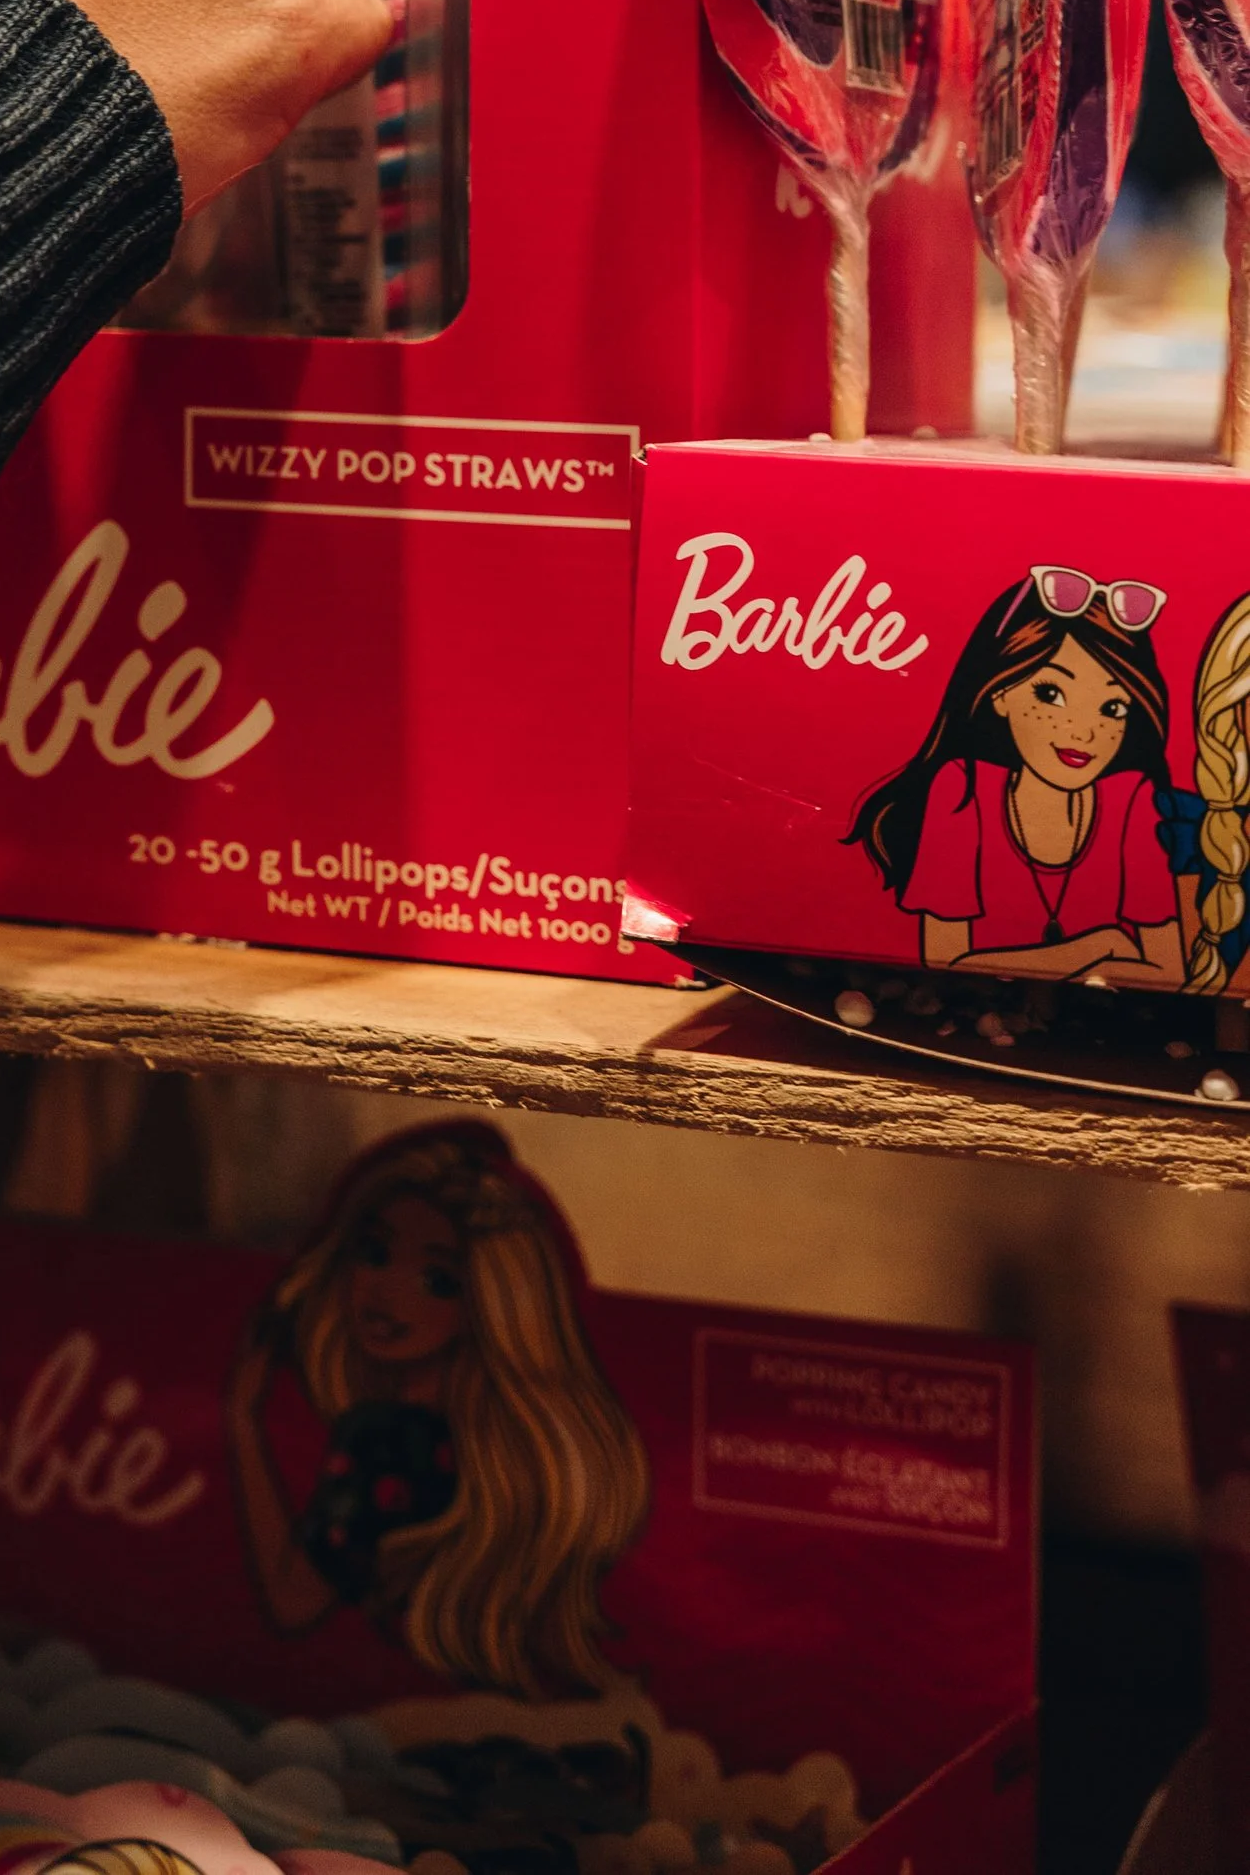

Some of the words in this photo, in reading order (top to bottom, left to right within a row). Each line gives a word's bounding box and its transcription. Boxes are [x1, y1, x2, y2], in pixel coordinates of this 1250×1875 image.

[207, 443, 327, 480] WIZZY
[337, 449, 416, 484] POP
[661, 532, 929, 671] Barbie
[259, 849, 282, 885] g
[267, 889, 317, 918] Net
[324, 895, 371, 923] WT
[400, 900, 473, 934] Poids
[479, 908, 533, 940] Net
[539, 916, 612, 946] 1000
